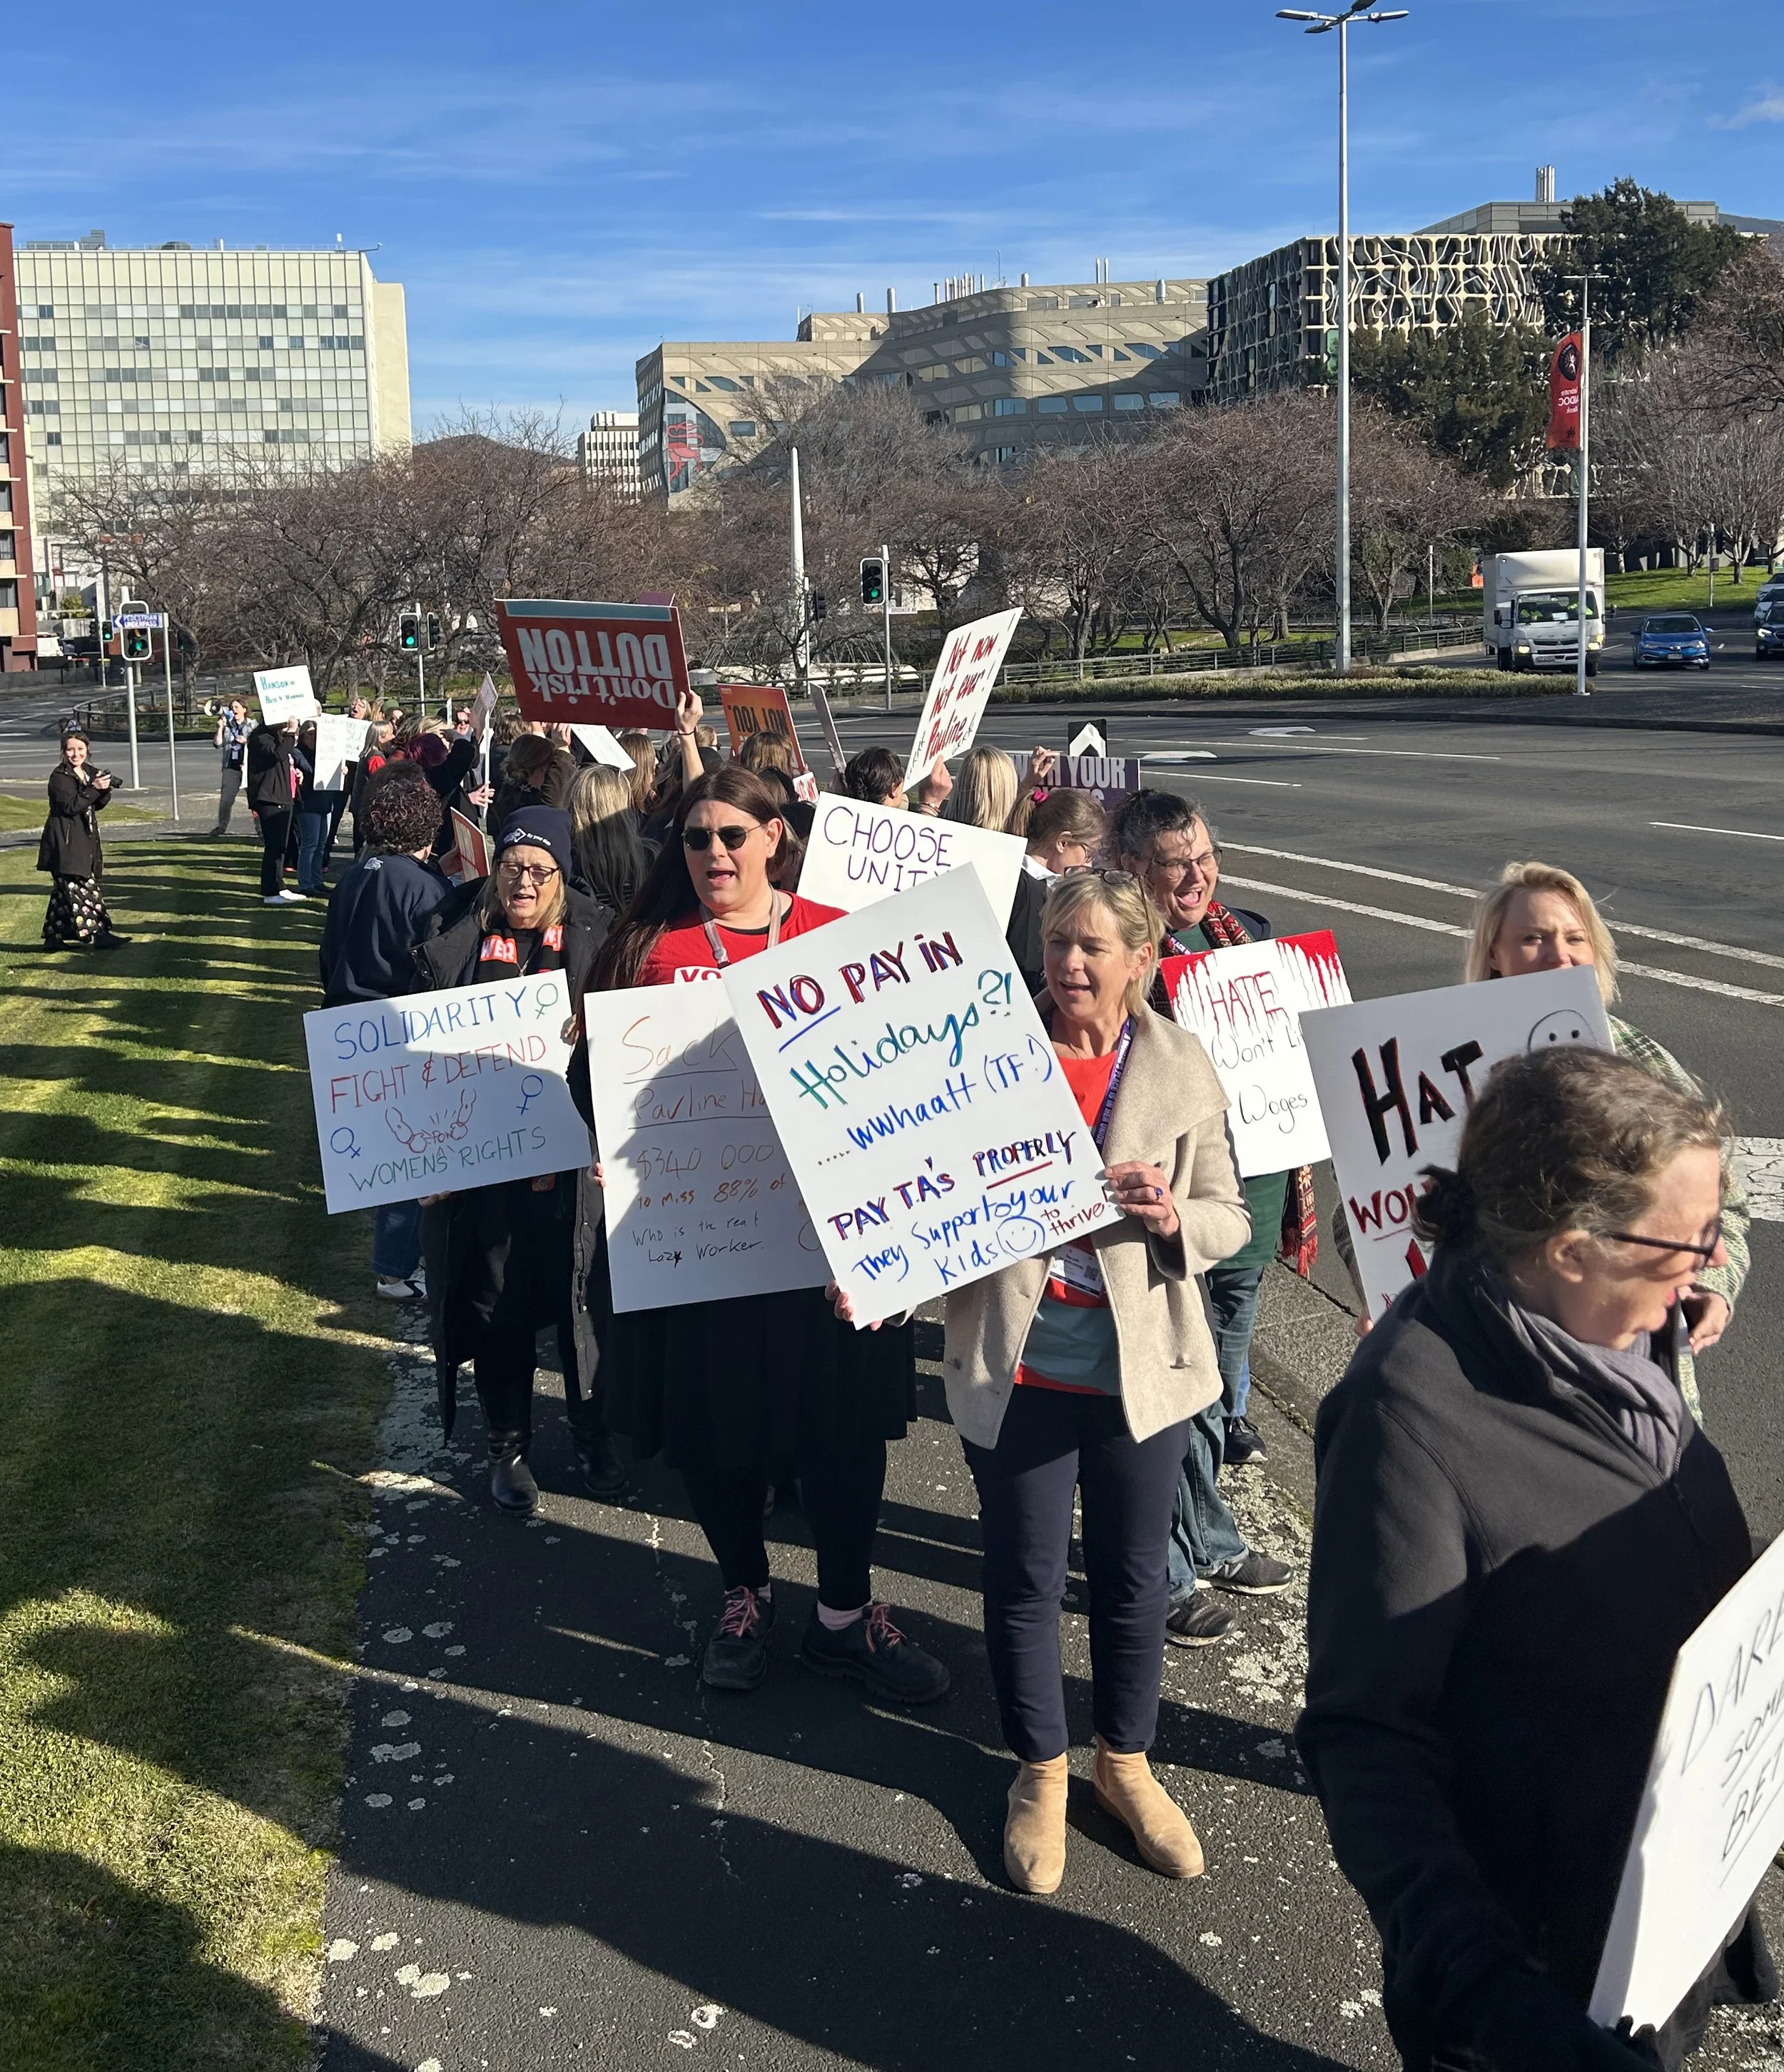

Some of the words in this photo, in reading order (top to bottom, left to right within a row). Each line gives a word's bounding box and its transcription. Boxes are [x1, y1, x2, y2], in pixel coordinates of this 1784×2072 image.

[515, 627, 673, 679] DUTTON
[942, 631, 972, 681] Not
[527, 671, 590, 704] risk
[592, 674, 677, 709] Don't
[928, 673, 958, 723] Not
[922, 709, 968, 768] Pauline
[1067, 756, 1126, 789] YOUR
[823, 806, 953, 868] CHOOSE
[847, 853, 951, 893] UNIT
[756, 974, 826, 1030] NO
[838, 940, 911, 1005] PAY
[1206, 970, 1284, 1035] HATE
[333, 985, 527, 1060] SOLIDARITY
[1211, 1030, 1274, 1070] Won't
[330, 1064, 410, 1114] FIGHT
[445, 1035, 547, 1085] DEFEND
[457, 1126, 547, 1168] RIGHTS
[637, 1147, 702, 1181] $340
[721, 1144, 774, 1170] 000
[637, 1196, 652, 1209] to
[713, 1178, 759, 1203] 88%
[770, 1172, 787, 1190] of
[827, 1197, 891, 1241] PAY
[972, 1129, 1078, 1177] PROPERLY
[632, 1228, 664, 1246] Who
[674, 1226, 685, 1238] is
[699, 1220, 717, 1234] the
[1040, 1208, 1061, 1222] to
[851, 1243, 911, 1283] They
